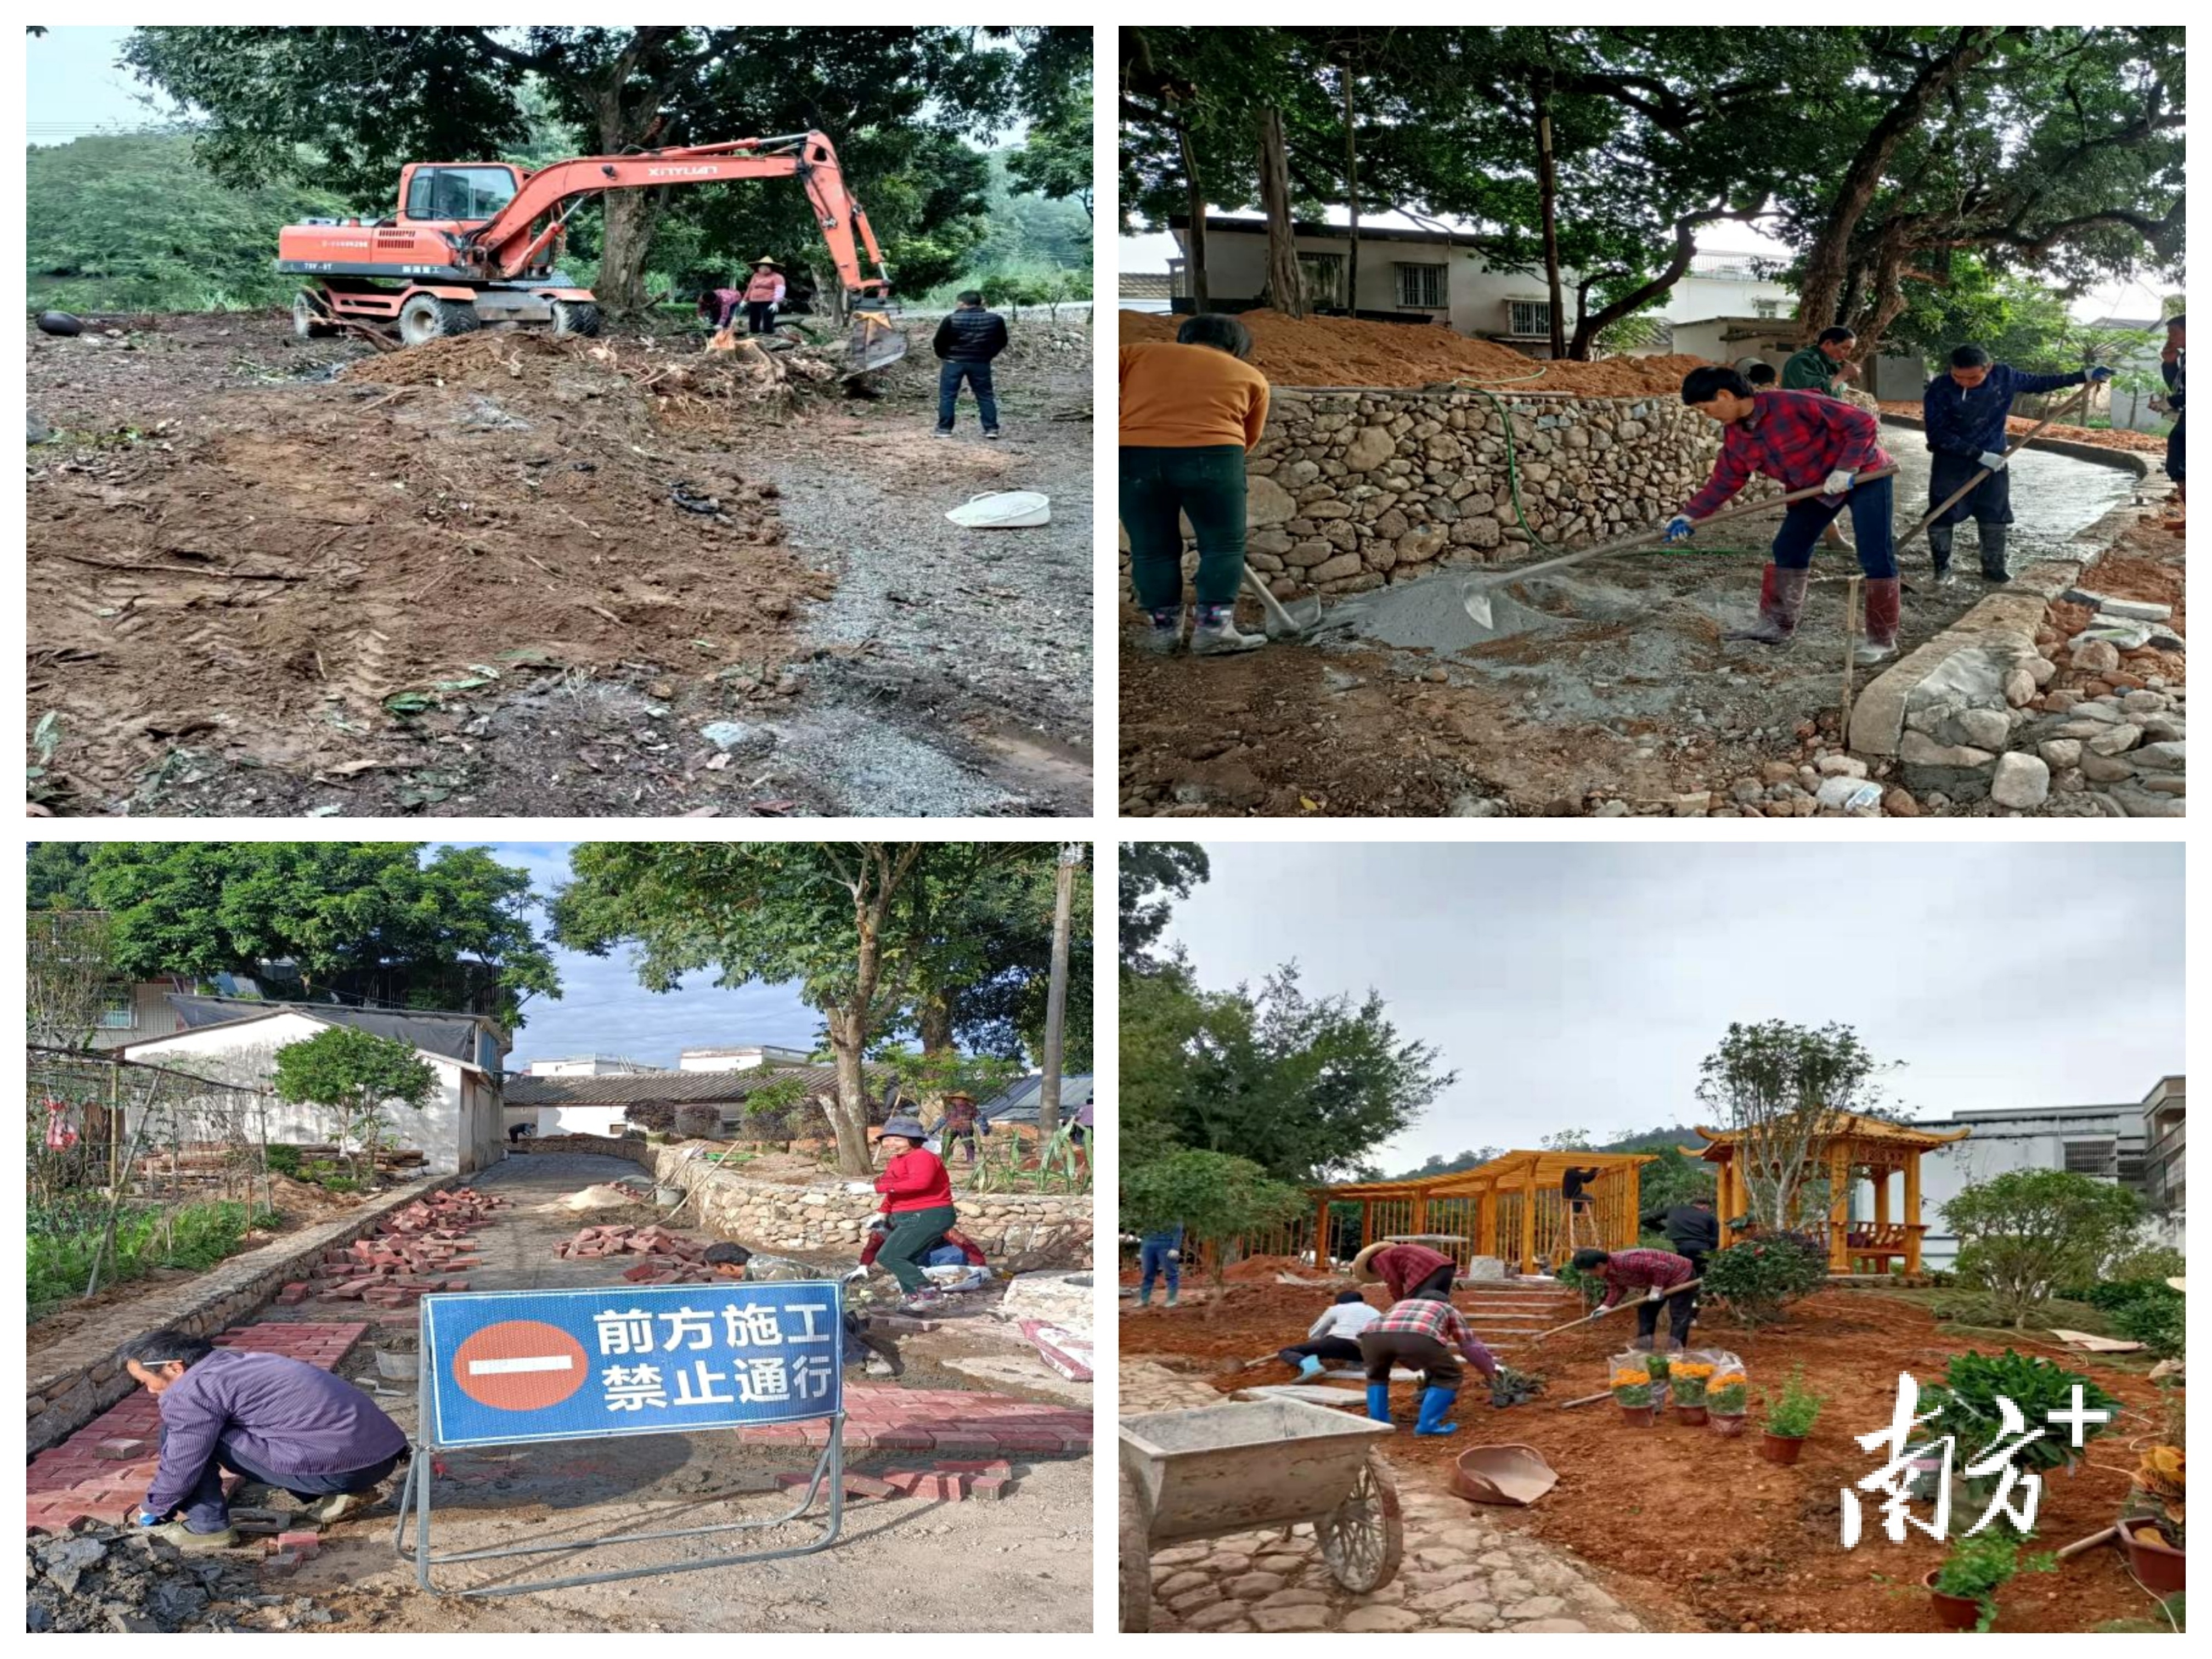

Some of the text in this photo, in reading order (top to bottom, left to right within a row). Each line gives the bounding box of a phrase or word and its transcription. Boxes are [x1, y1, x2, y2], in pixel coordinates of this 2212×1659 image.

[593, 1302, 830, 1355] 前方施工
[602, 1353, 832, 1413] 禁止通行
